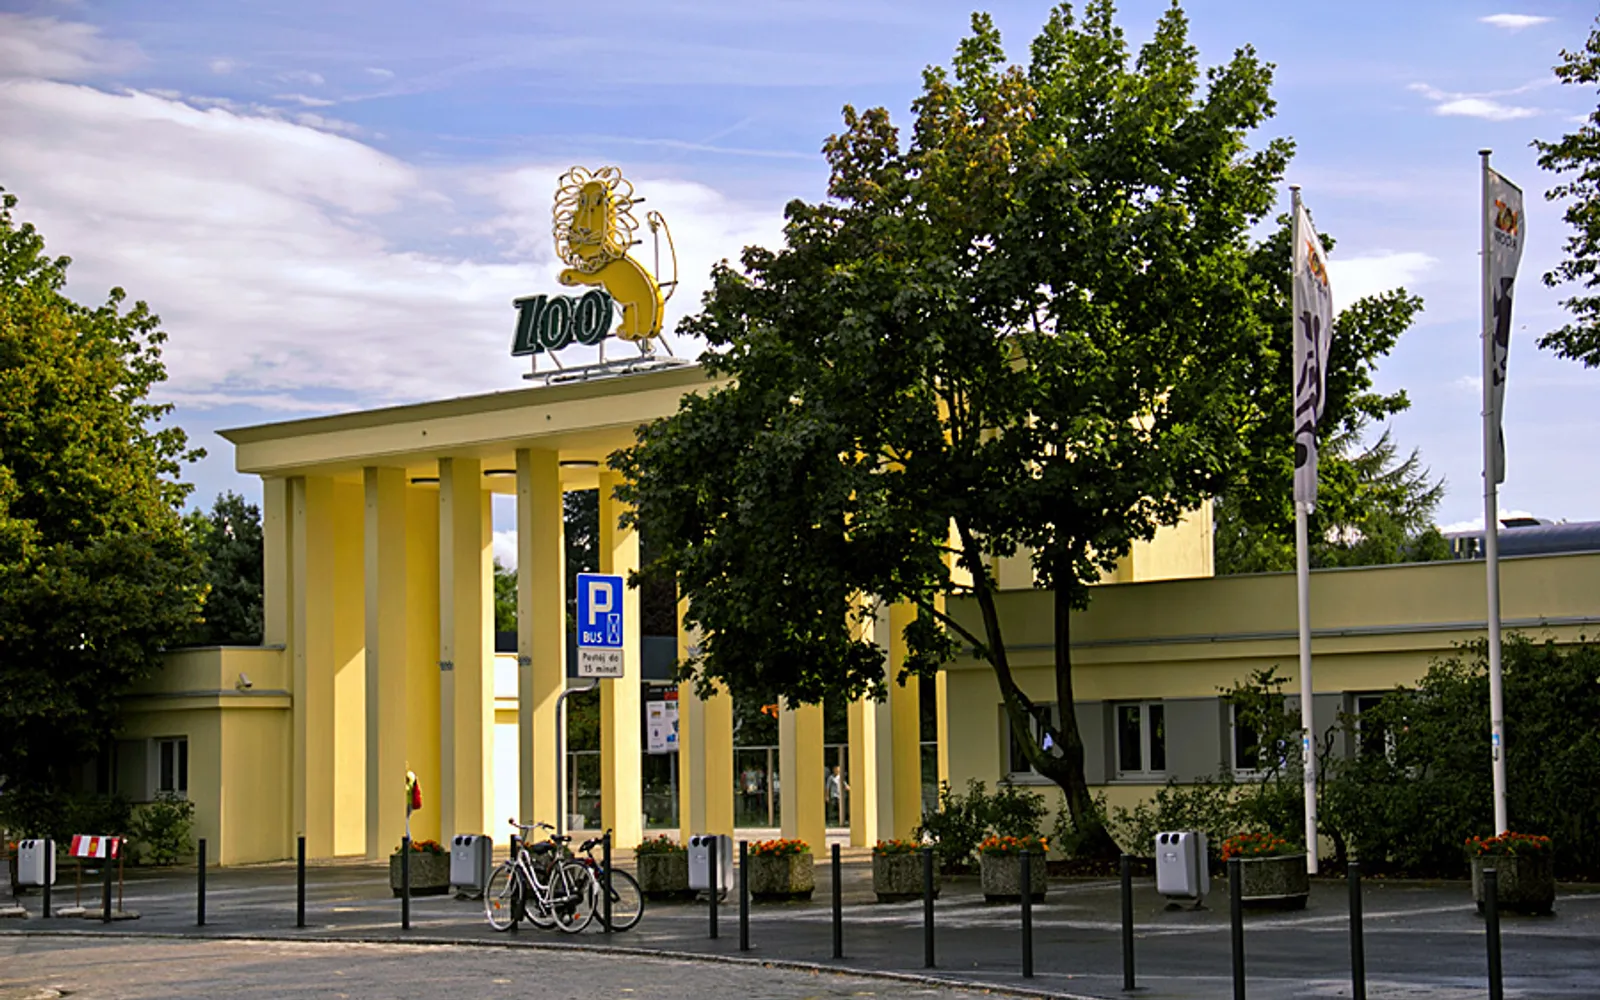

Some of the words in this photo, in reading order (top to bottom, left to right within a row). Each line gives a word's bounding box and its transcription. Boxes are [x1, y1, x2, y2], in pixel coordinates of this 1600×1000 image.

[588, 581, 613, 625] P
[583, 631, 603, 643] BUS
[608, 653, 620, 663] do
[584, 664, 594, 674] 15
[596, 665, 618, 674] minut
